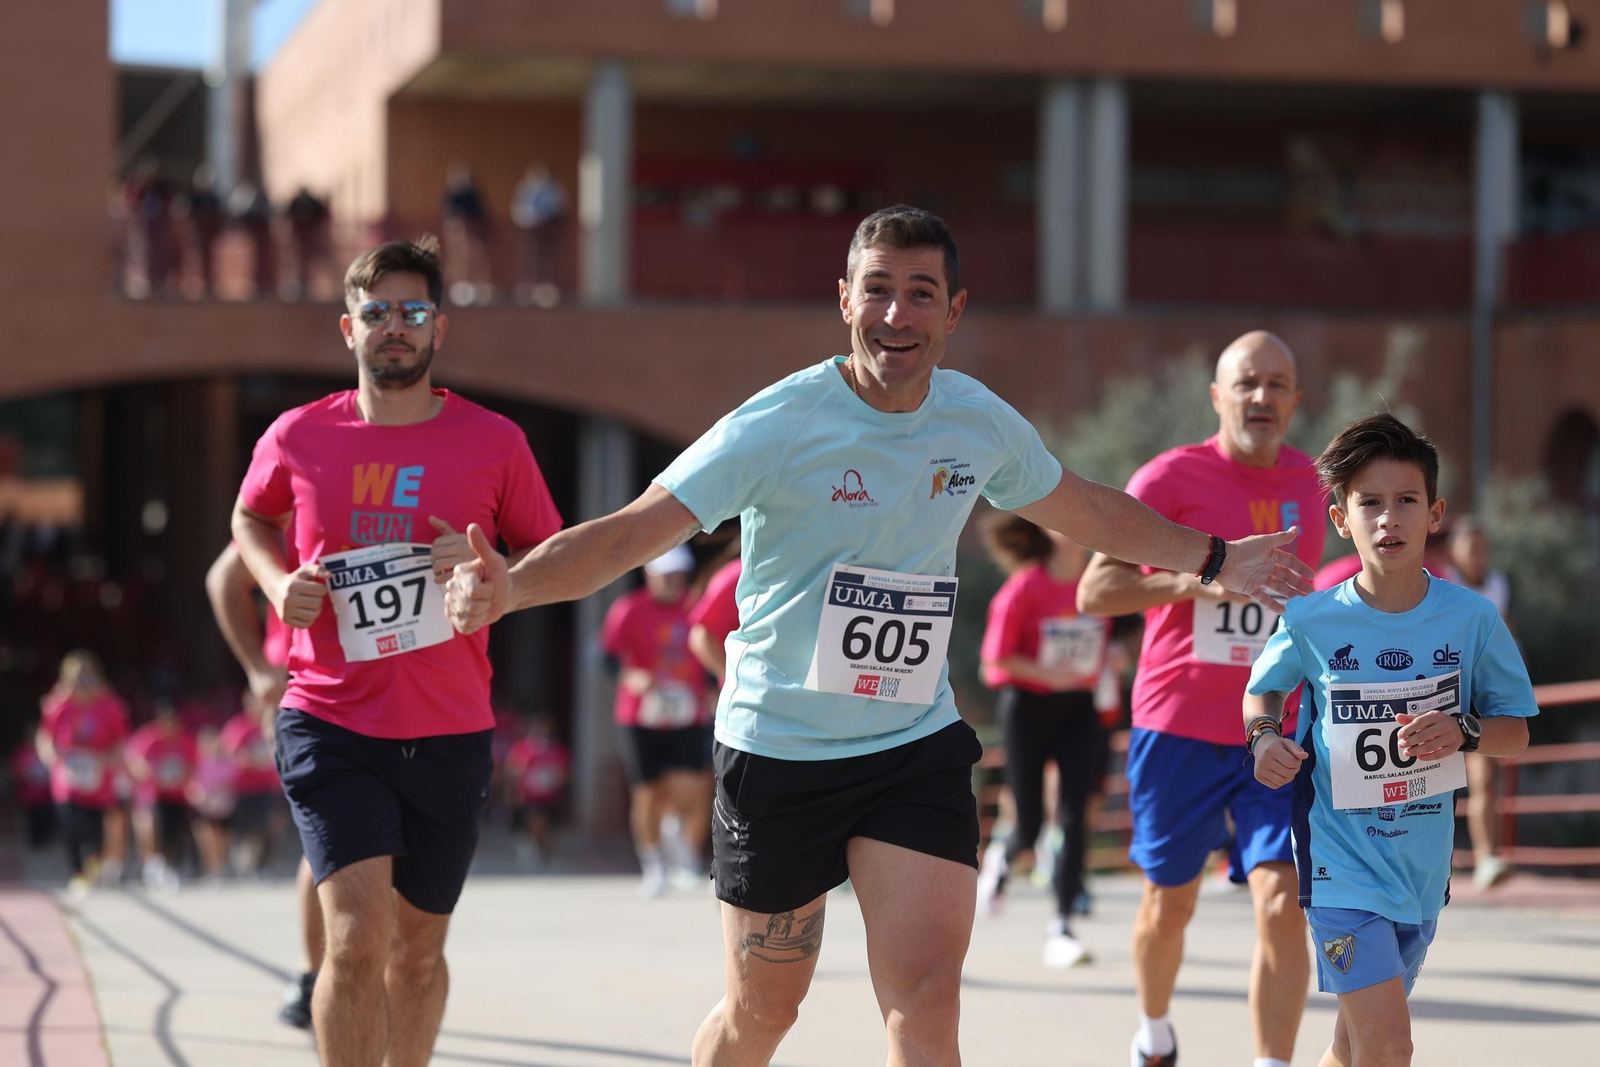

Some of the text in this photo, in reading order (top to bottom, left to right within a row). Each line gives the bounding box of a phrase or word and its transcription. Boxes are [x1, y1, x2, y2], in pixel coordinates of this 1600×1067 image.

[352, 462, 425, 508] WE
[948, 470, 976, 488] Álora
[1248, 501, 1302, 535] WE
[355, 514, 409, 542] RUN
[332, 566, 379, 587] UMA
[349, 576, 426, 629] 197
[834, 586, 895, 610] UMA
[842, 616, 933, 666] 605
[1328, 658, 1360, 666] CUEVA
[1378, 652, 1411, 668] TROPS
[1432, 644, 1460, 665] als
[857, 679, 879, 691] WE
[882, 676, 901, 685] RUN
[1410, 683, 1434, 691] SOLIDARIA
[879, 689, 897, 698] RUN
[1363, 692, 1402, 700] UNIVERSIDAD
[1335, 703, 1396, 720] UMA
[1356, 726, 1417, 772] 60
[1387, 770, 1412, 778] SALAZAR
[1413, 763, 1441, 774] FERNÁNDEZ
[1408, 776, 1426, 785] RUN
[1384, 786, 1407, 798] WE
[1409, 787, 1426, 798] RUN
